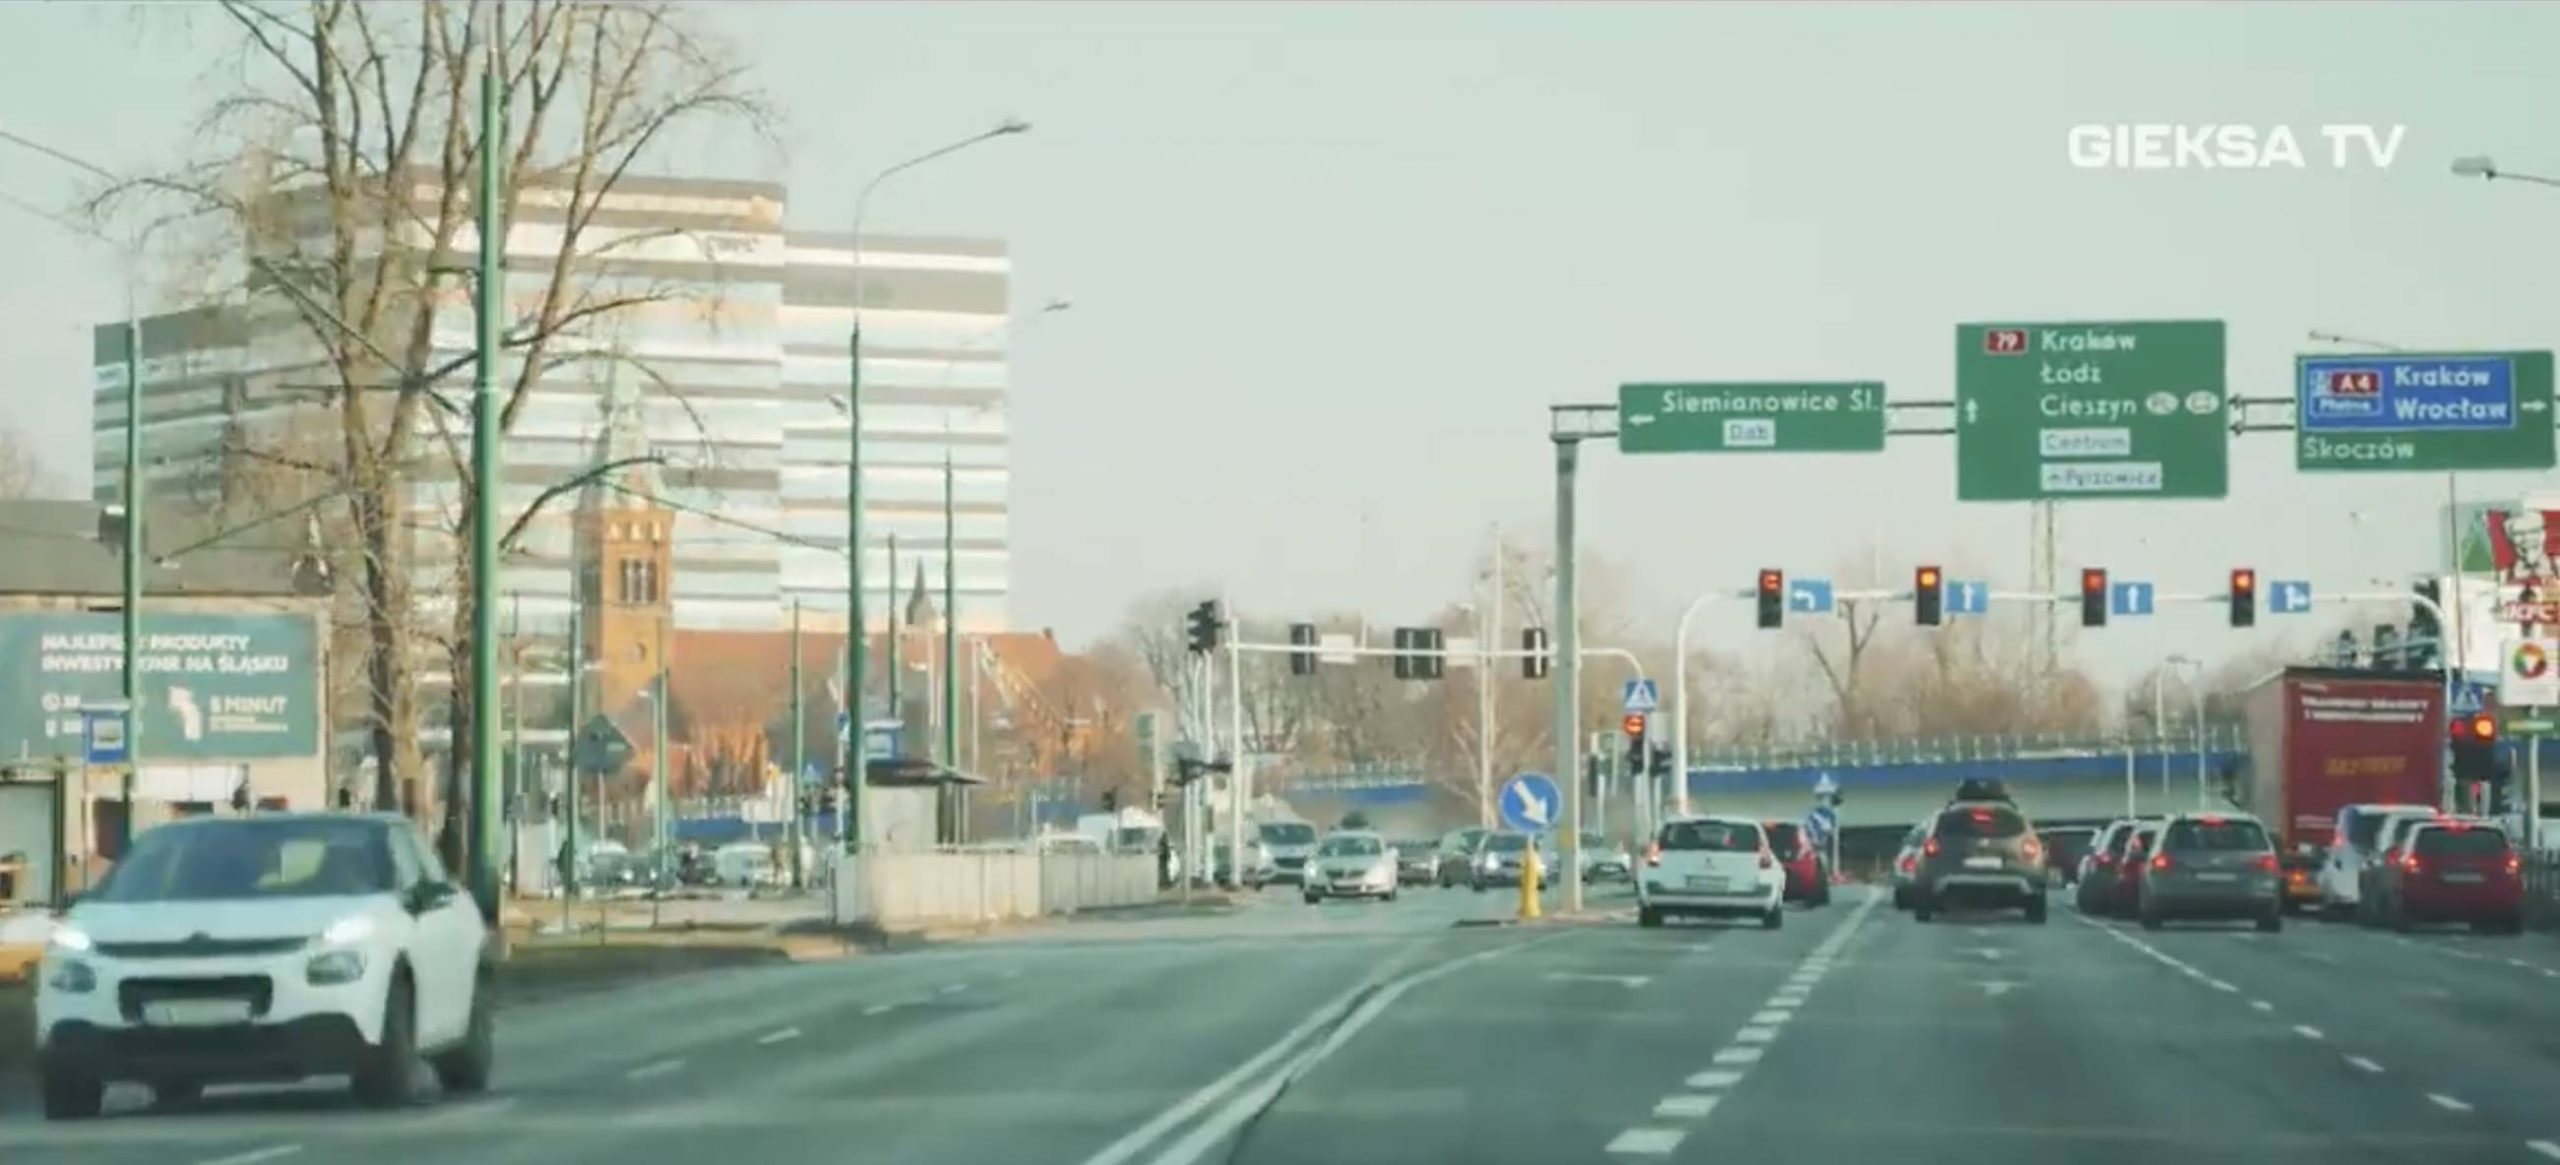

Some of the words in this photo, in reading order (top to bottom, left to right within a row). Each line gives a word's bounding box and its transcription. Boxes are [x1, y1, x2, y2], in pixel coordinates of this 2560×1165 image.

[1997, 333, 2018, 350] 79
[2041, 330, 2136, 350] Kraków
[2394, 366, 2490, 386] Kraków
[1661, 390, 1838, 413] Siemianowice
[2040, 394, 2137, 421] Cieszyn
[2394, 398, 2508, 419] Wrocław
[2047, 434, 2126, 449] Centrum
[2303, 436, 2414, 458] Skoczów
[151, 633, 250, 651] PRODUKTY
[186, 656, 213, 671] NA
[217, 652, 289, 675] ŚLĄSKU
[224, 696, 288, 714] MINUT
